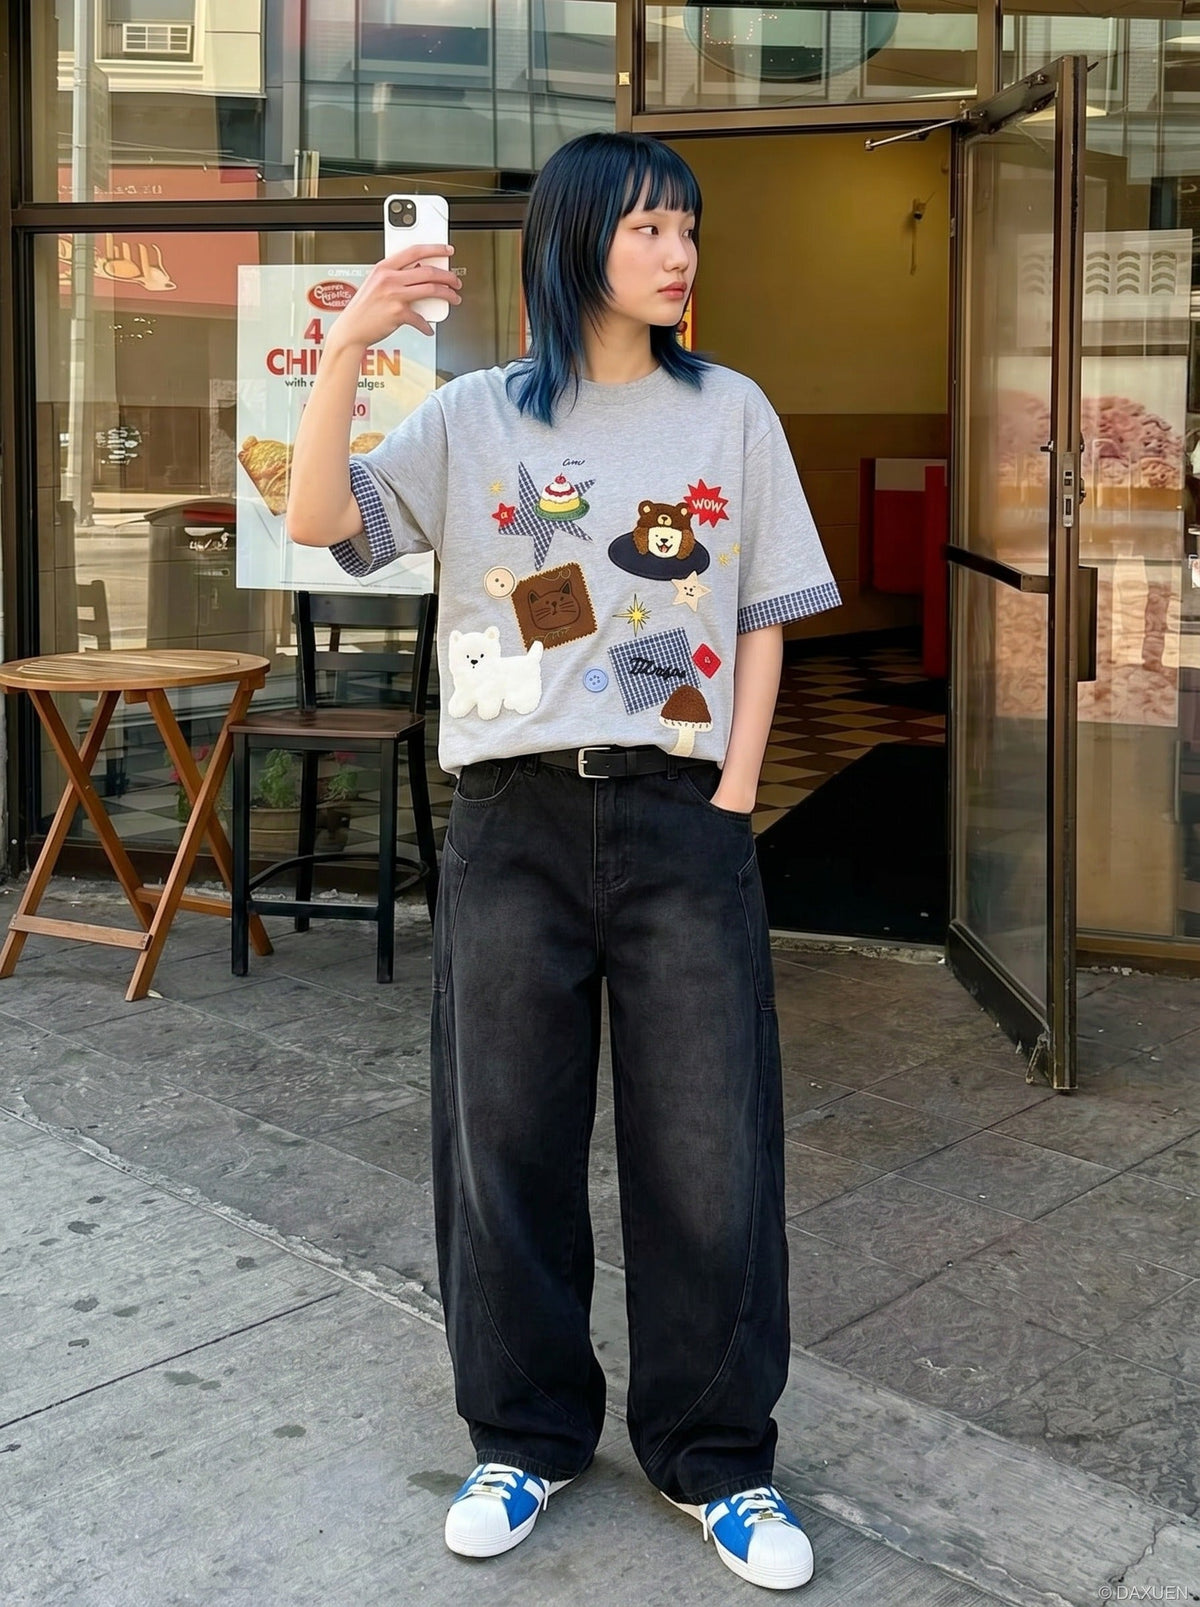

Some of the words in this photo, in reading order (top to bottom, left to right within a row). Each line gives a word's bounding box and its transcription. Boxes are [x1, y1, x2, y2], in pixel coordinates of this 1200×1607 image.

[304, 318, 324, 345] 4
[266, 348, 401, 376] CHIEN
[285, 377, 307, 388] with
[691, 498, 724, 514] WOW
